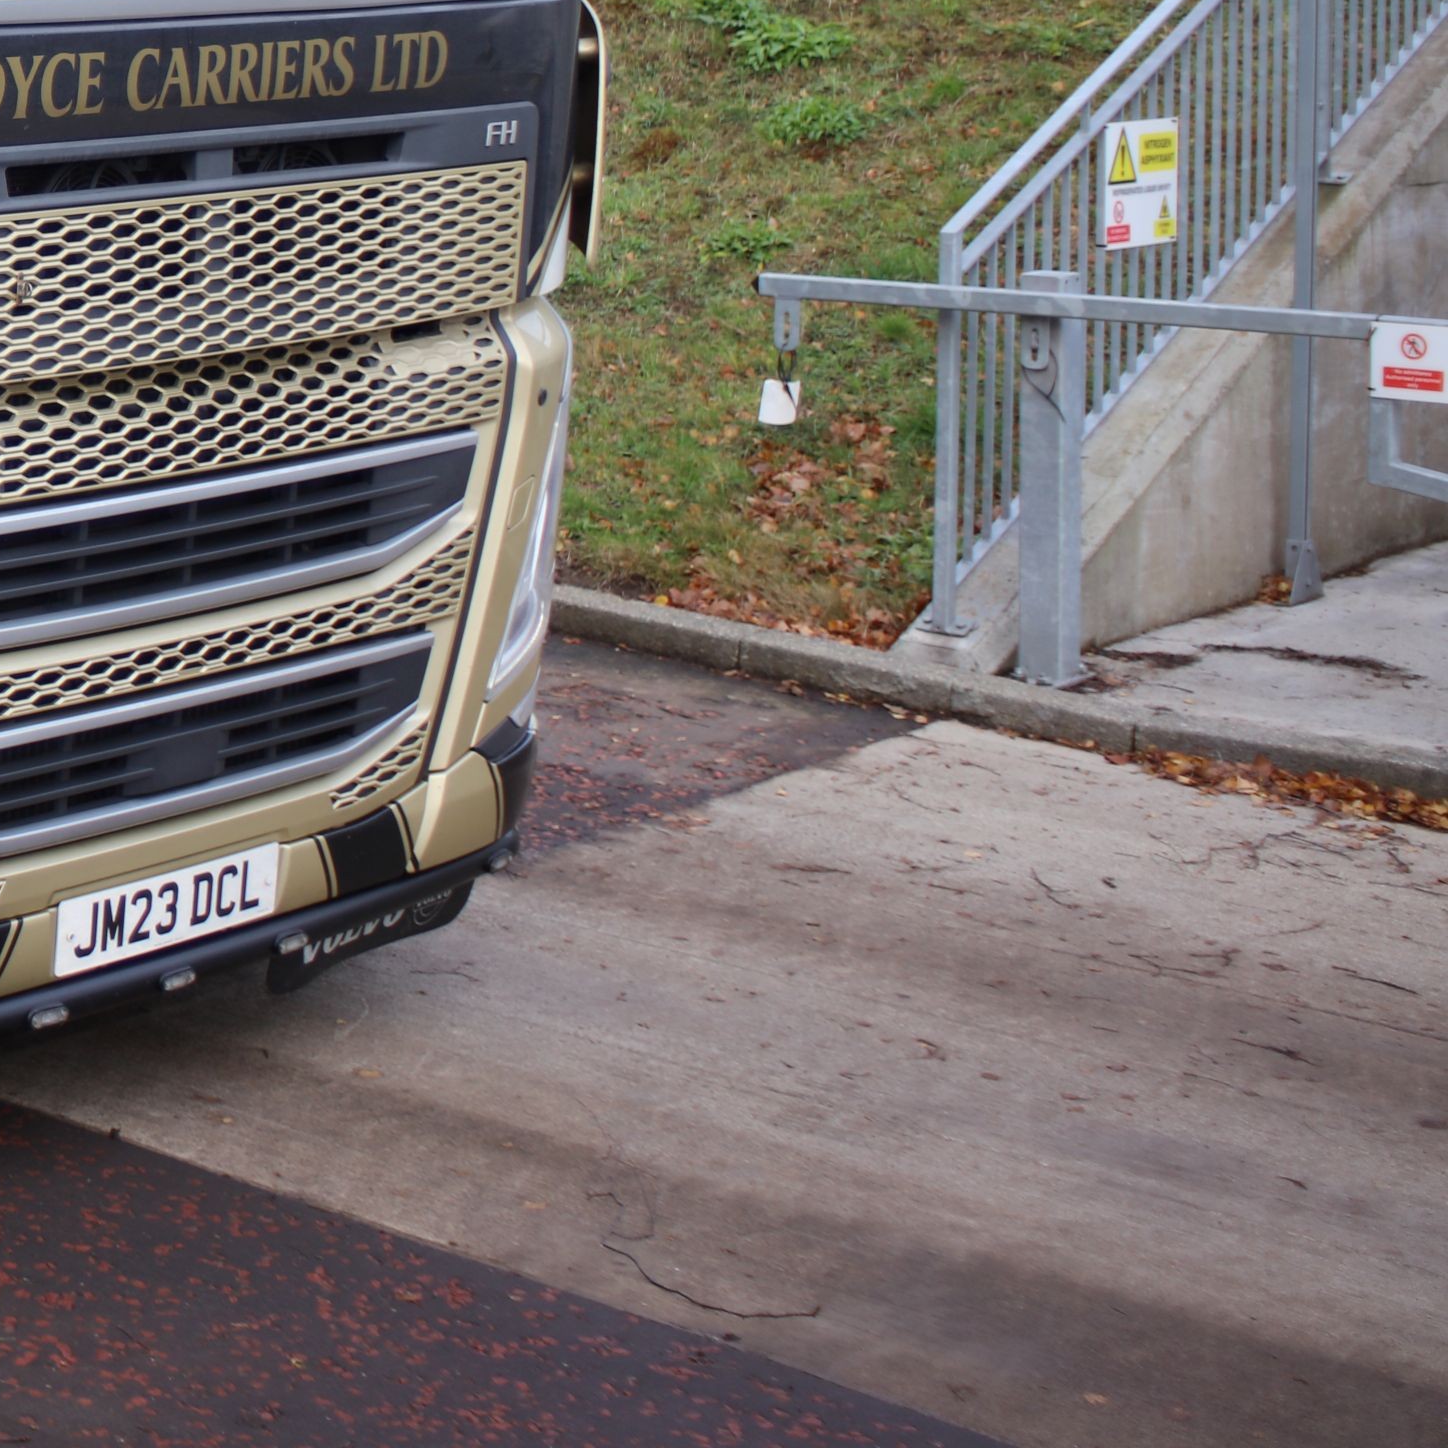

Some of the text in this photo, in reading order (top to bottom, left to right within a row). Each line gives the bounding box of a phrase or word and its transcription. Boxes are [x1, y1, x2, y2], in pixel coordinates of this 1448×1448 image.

[125, 35, 356, 111] CARRIERS
[369, 29, 448, 93] LTD
[485, 119, 517, 147] FH
[74, 860, 259, 960] JM23 DCL
